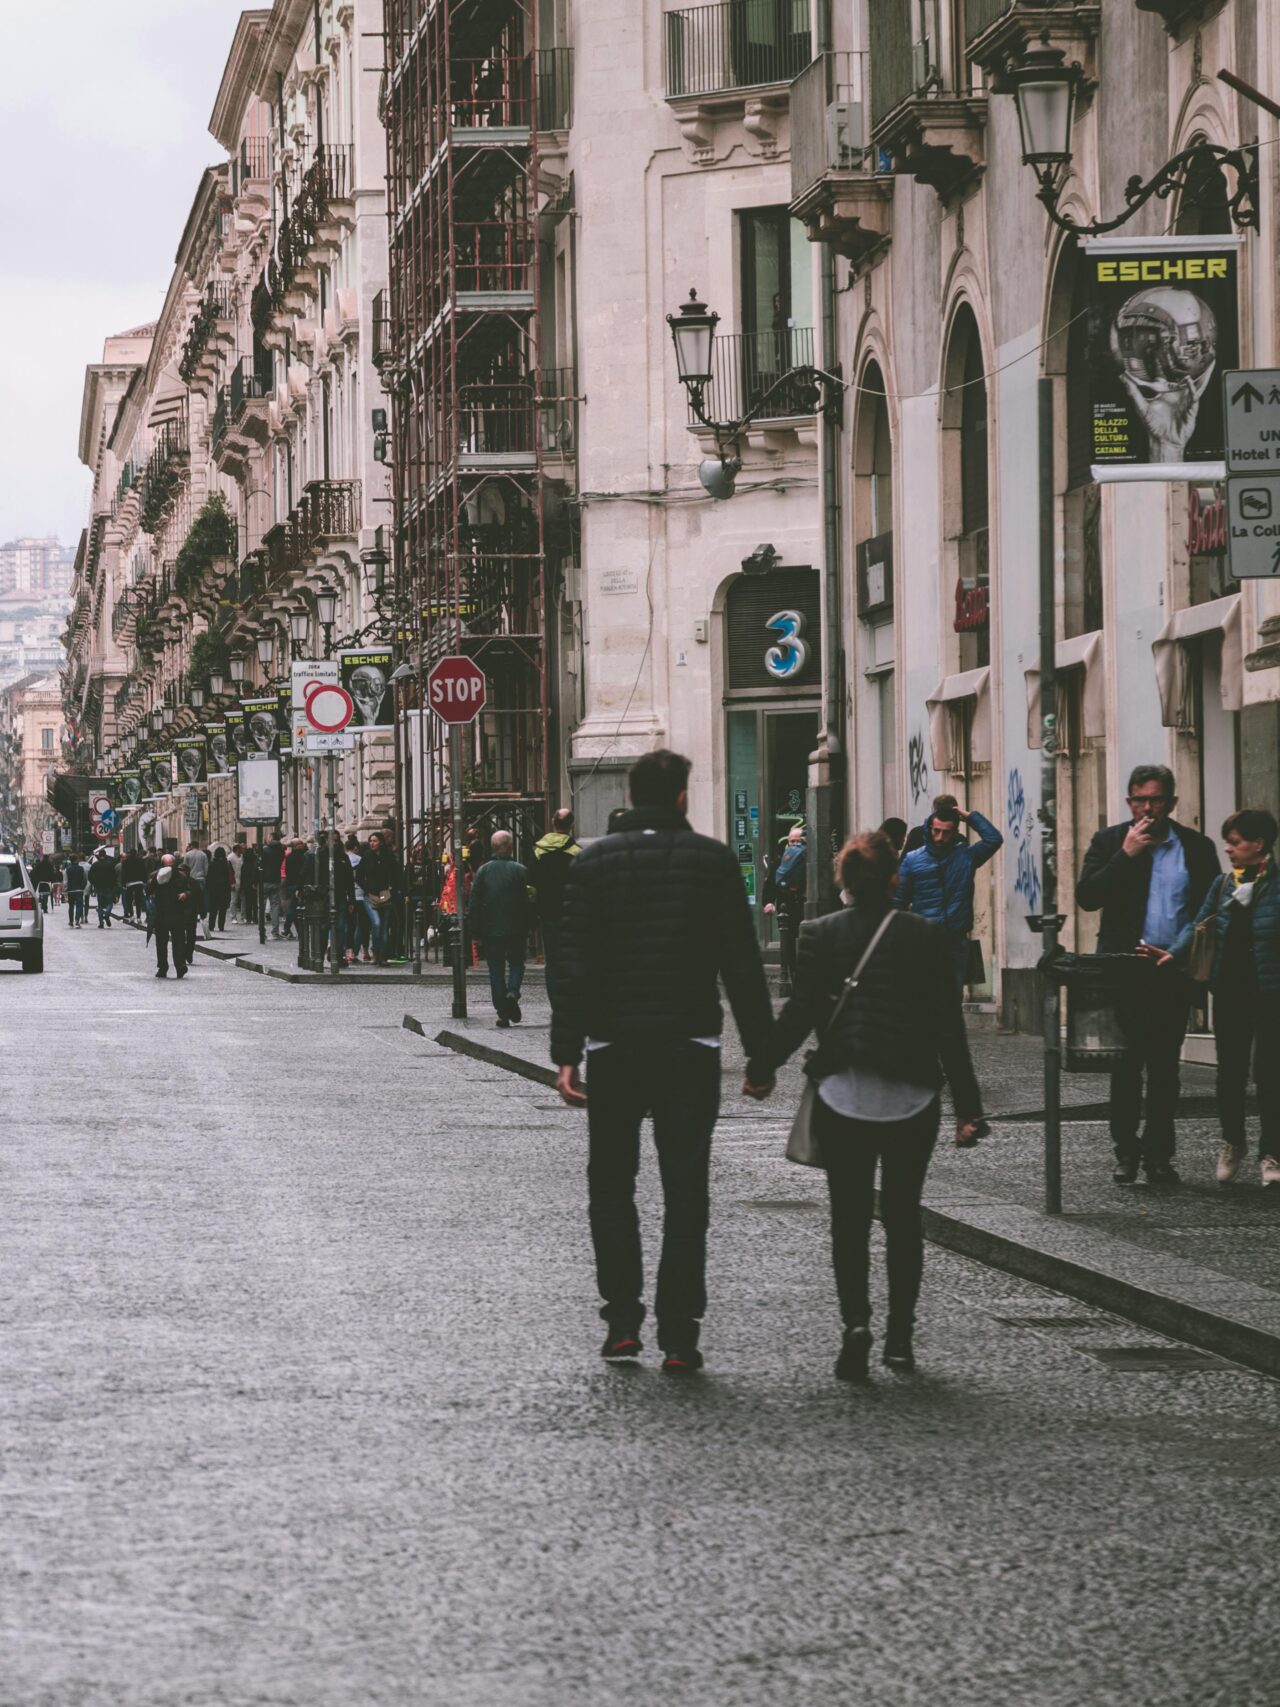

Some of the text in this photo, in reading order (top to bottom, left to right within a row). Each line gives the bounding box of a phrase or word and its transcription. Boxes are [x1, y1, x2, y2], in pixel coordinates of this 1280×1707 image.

[1097, 258, 1227, 282] ESCHER
[1094, 434, 1129, 442] CULTURA
[1095, 446, 1127, 454] CATANIA
[1231, 448, 1270, 461] Hotel
[1231, 525, 1249, 538] La
[765, 609, 807, 680] 3
[344, 655, 389, 665] ESCHER
[432, 677, 482, 703] STOP
[245, 704, 279, 712] ESCHER
[98, 825, 109, 834] 20
